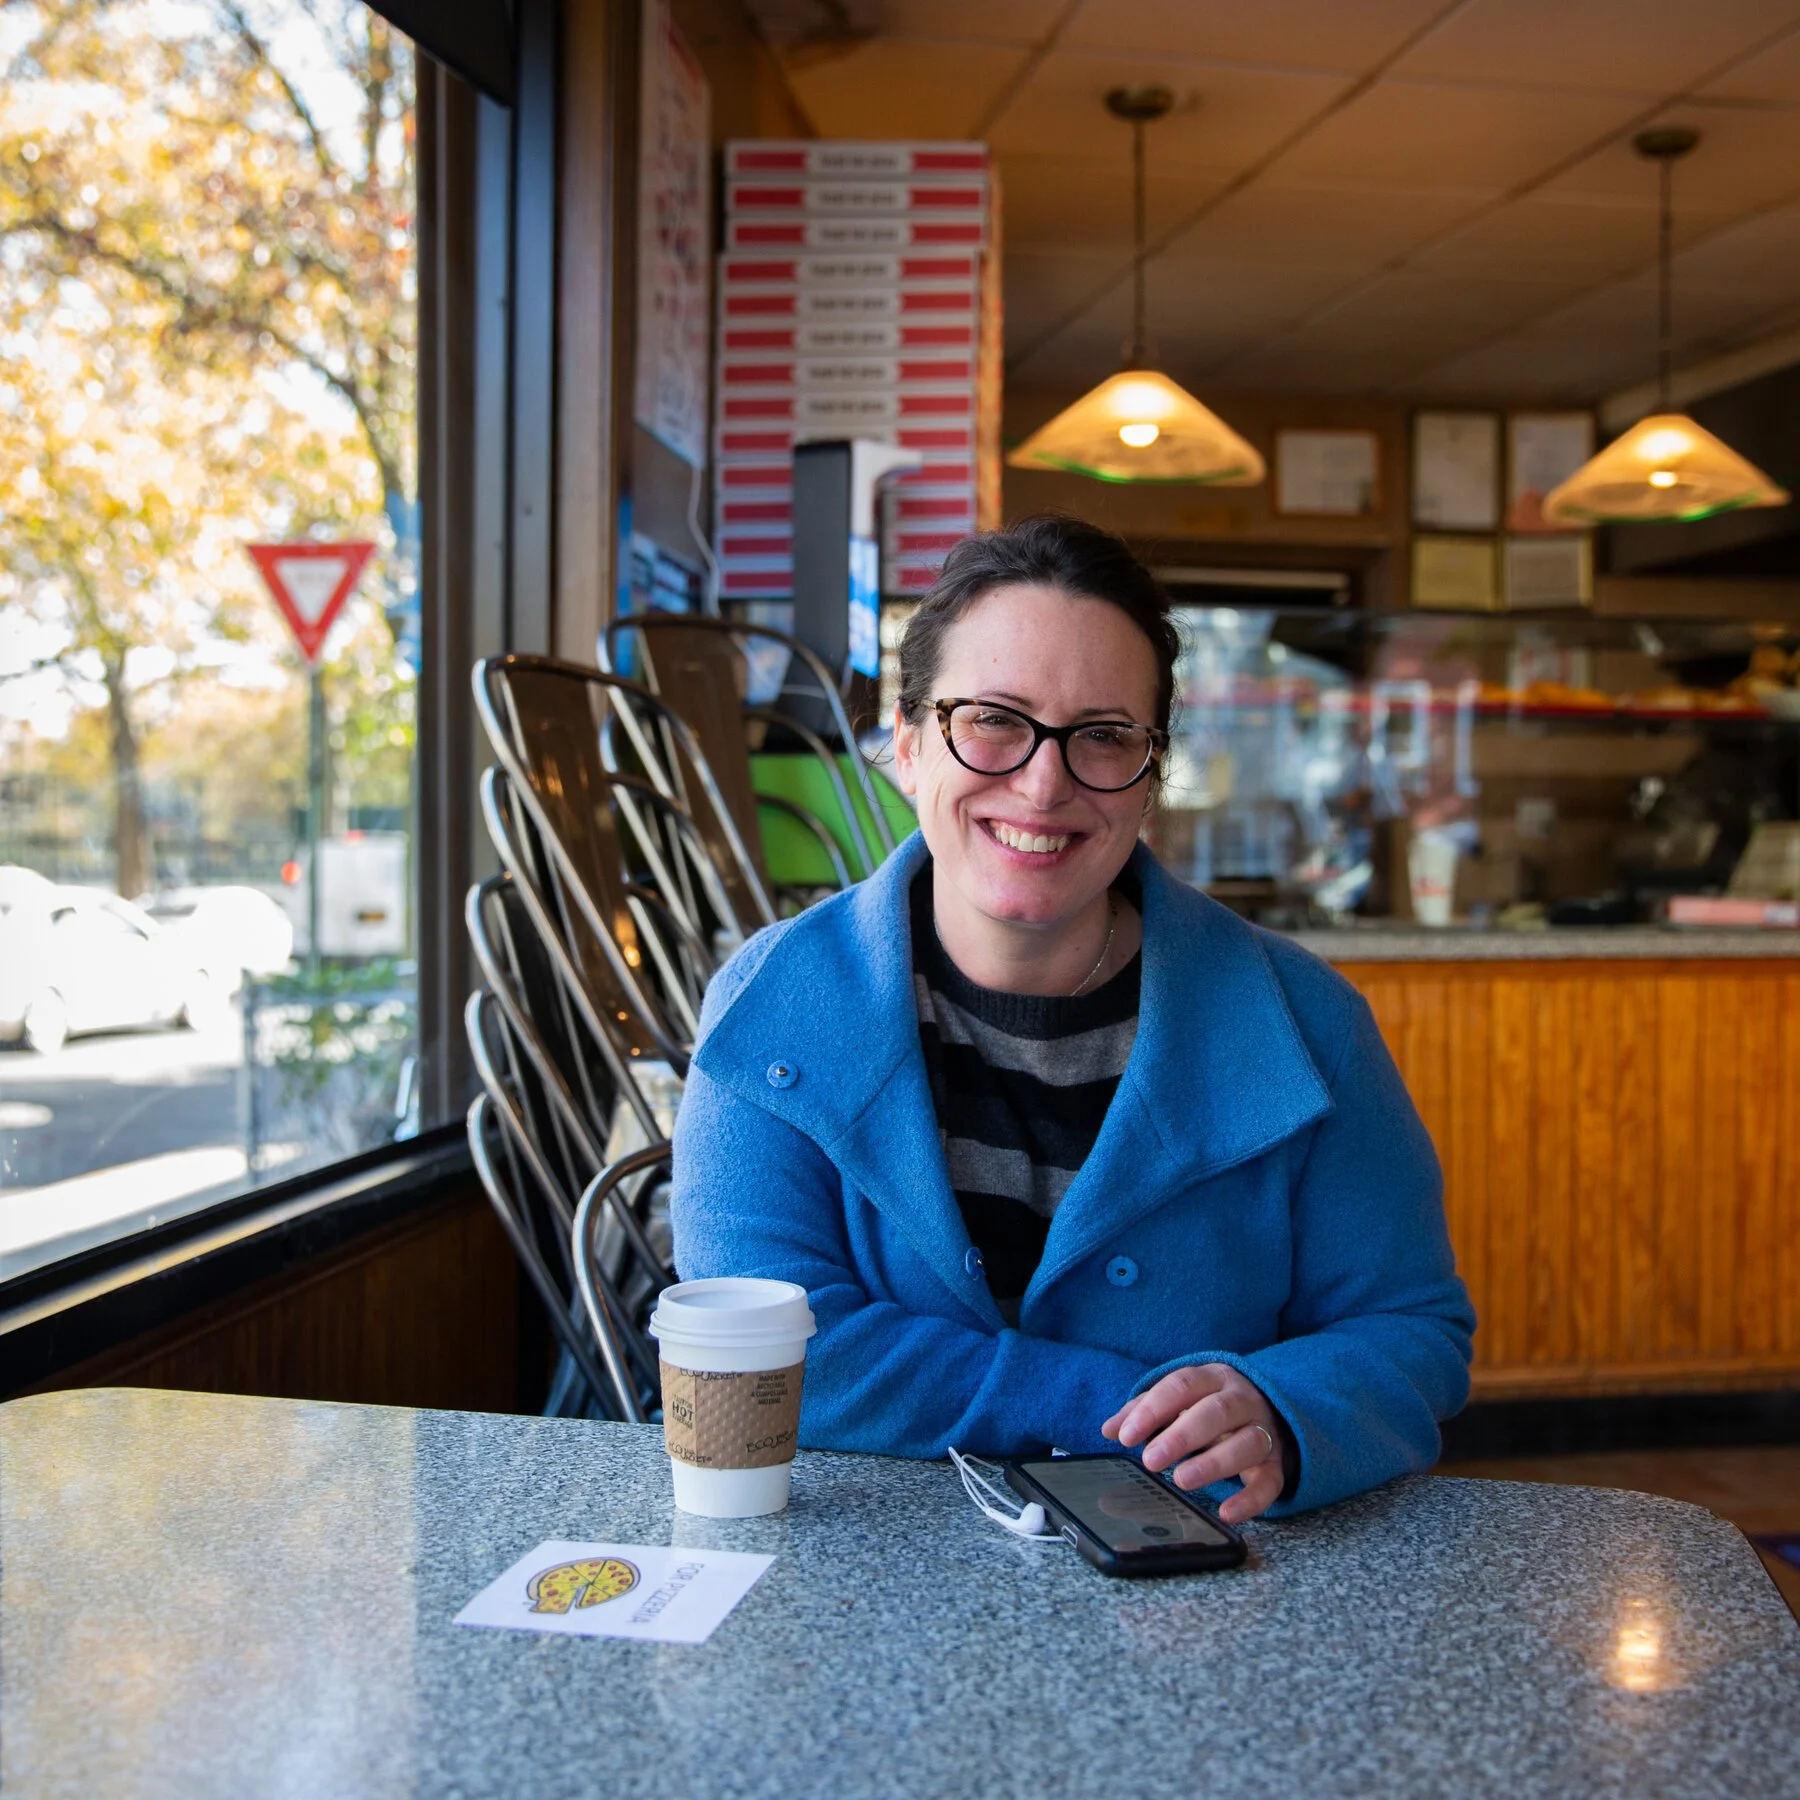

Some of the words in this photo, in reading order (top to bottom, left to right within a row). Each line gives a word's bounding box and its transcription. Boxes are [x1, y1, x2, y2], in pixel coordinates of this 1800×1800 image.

[672, 1401, 694, 1421] HOT
[668, 1562, 705, 1581] FOR
[626, 1582, 686, 1623] PIZZERIA
